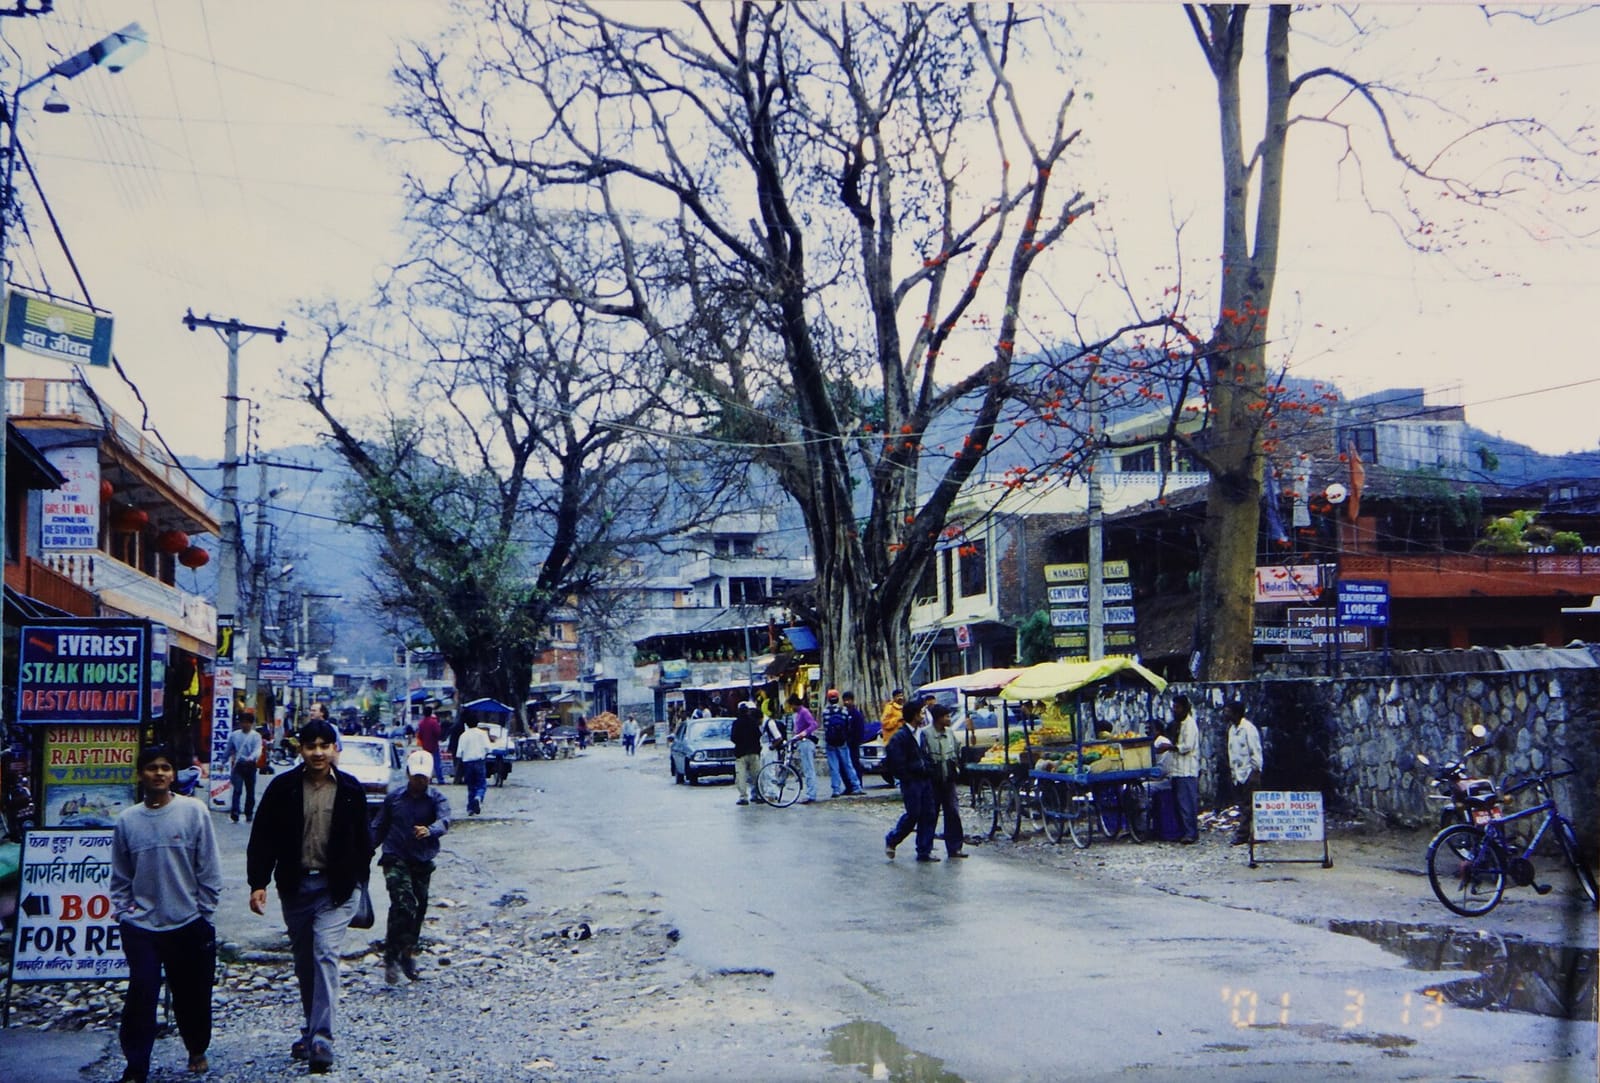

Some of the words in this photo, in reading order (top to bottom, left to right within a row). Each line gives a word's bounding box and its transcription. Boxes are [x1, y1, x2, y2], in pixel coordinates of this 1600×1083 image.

[23, 329, 47, 347] नव
[49, 334, 93, 357] जीवन
[44, 504, 70, 514] GREAT
[74, 504, 94, 515] WALL
[1345, 604, 1378, 614] LODGE
[58, 635, 137, 656] EVEREST
[22, 663, 78, 684] STEAK
[83, 663, 138, 684] HOUSE
[21, 689, 138, 711] RESTAURANT
[93, 727, 138, 742] RIVER
[50, 748, 134, 765] RAFTING
[59, 895, 111, 921] BO
[18, 926, 76, 956] FOR
[85, 925, 121, 956] RE
